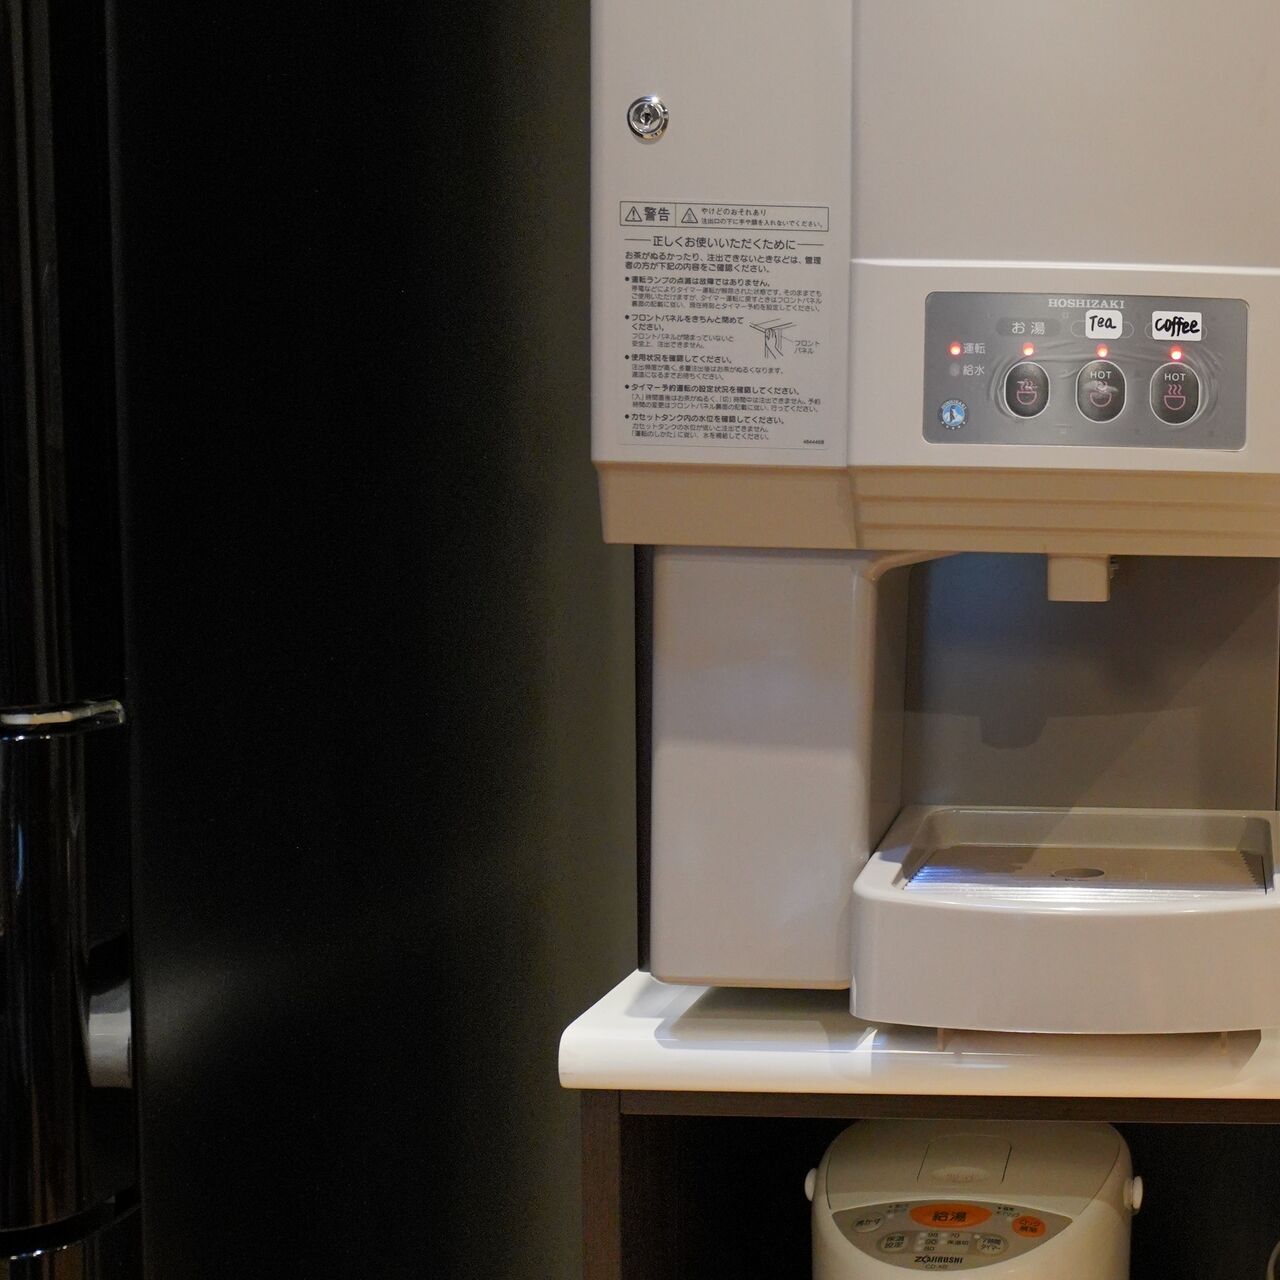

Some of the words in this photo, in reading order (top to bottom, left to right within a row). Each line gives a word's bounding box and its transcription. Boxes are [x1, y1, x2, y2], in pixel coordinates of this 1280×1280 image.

[644, 206, 670, 222] 警告
[701, 207, 766, 217] やけどのおそれあり
[653, 235, 796, 250] 正しくお使いいただくために
[1048, 298, 1126, 309] HOSHIZAKI
[631, 323, 665, 331] ください。
[1089, 315, 1117, 330] Tea
[963, 343, 986, 355] 運転
[963, 364, 985, 376] 給水
[1090, 370, 1111, 380] HOT
[1164, 372, 1186, 382] HOT
[932, 1210, 966, 1222] 給湯
[914, 1255, 963, 1265] ZOJIRUSHI
